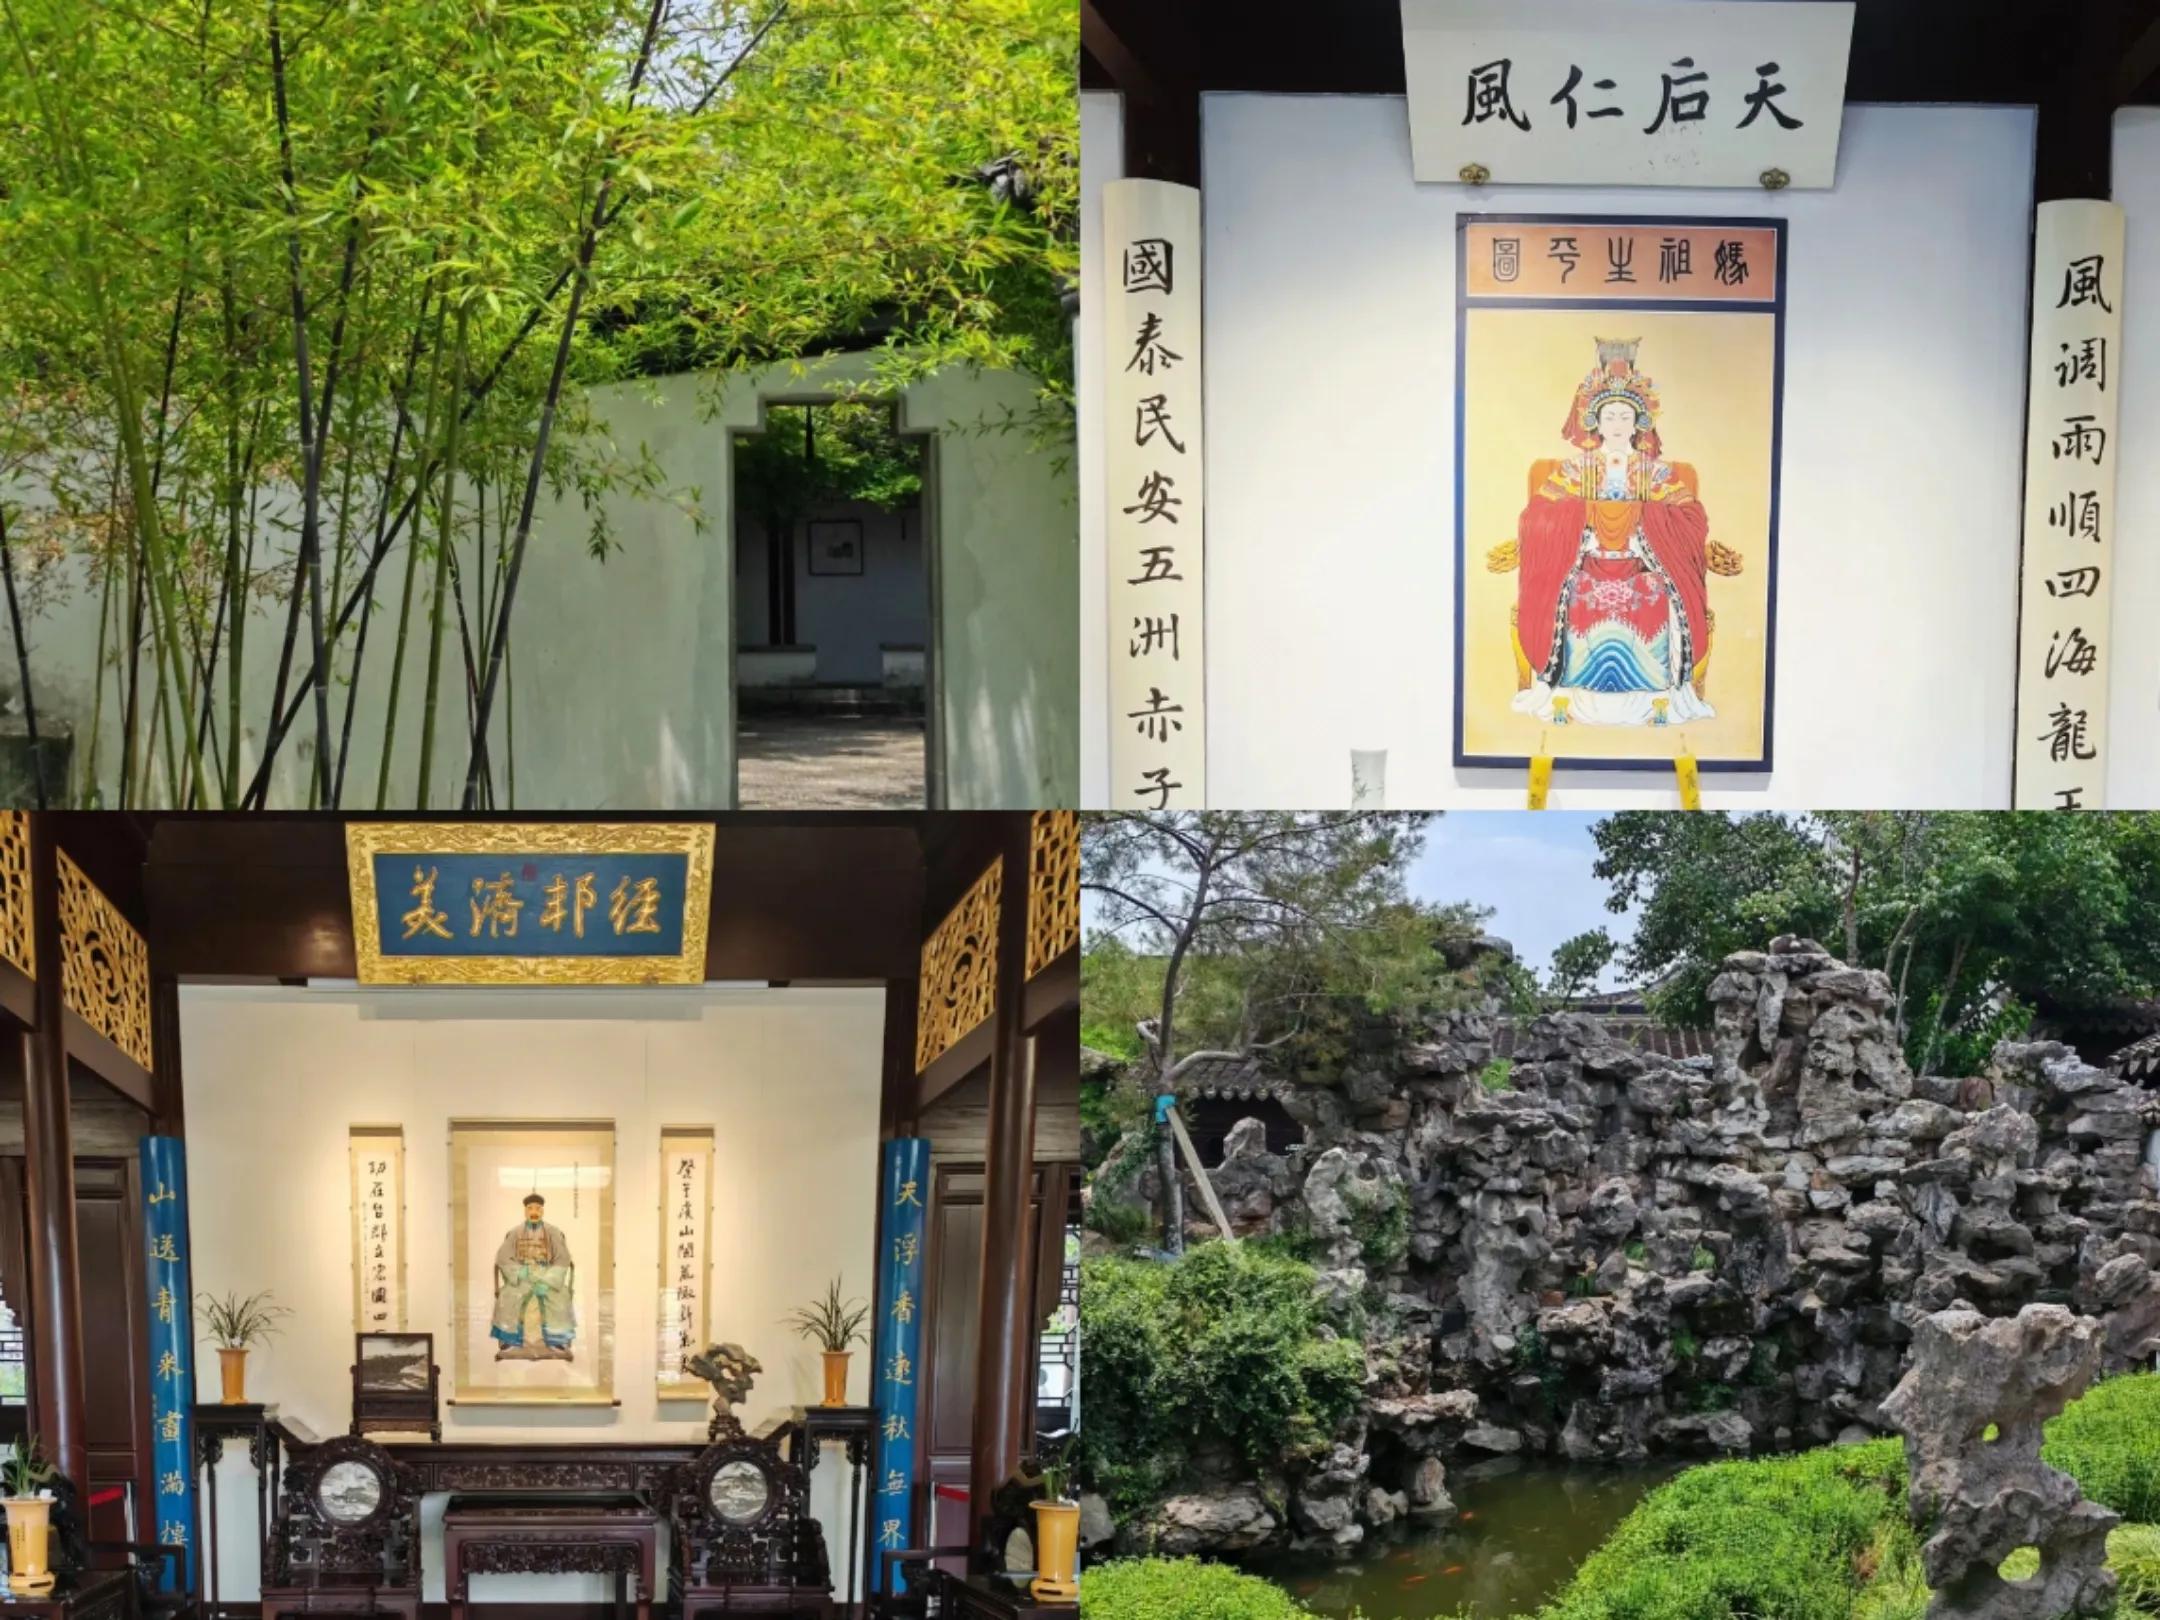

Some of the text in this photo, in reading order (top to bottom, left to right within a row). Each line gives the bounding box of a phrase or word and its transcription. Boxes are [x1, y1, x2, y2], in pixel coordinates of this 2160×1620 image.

[1462, 57, 1804, 134] 天后仁風
[1122, 237, 1186, 810] 國泰民安五洲赤子
